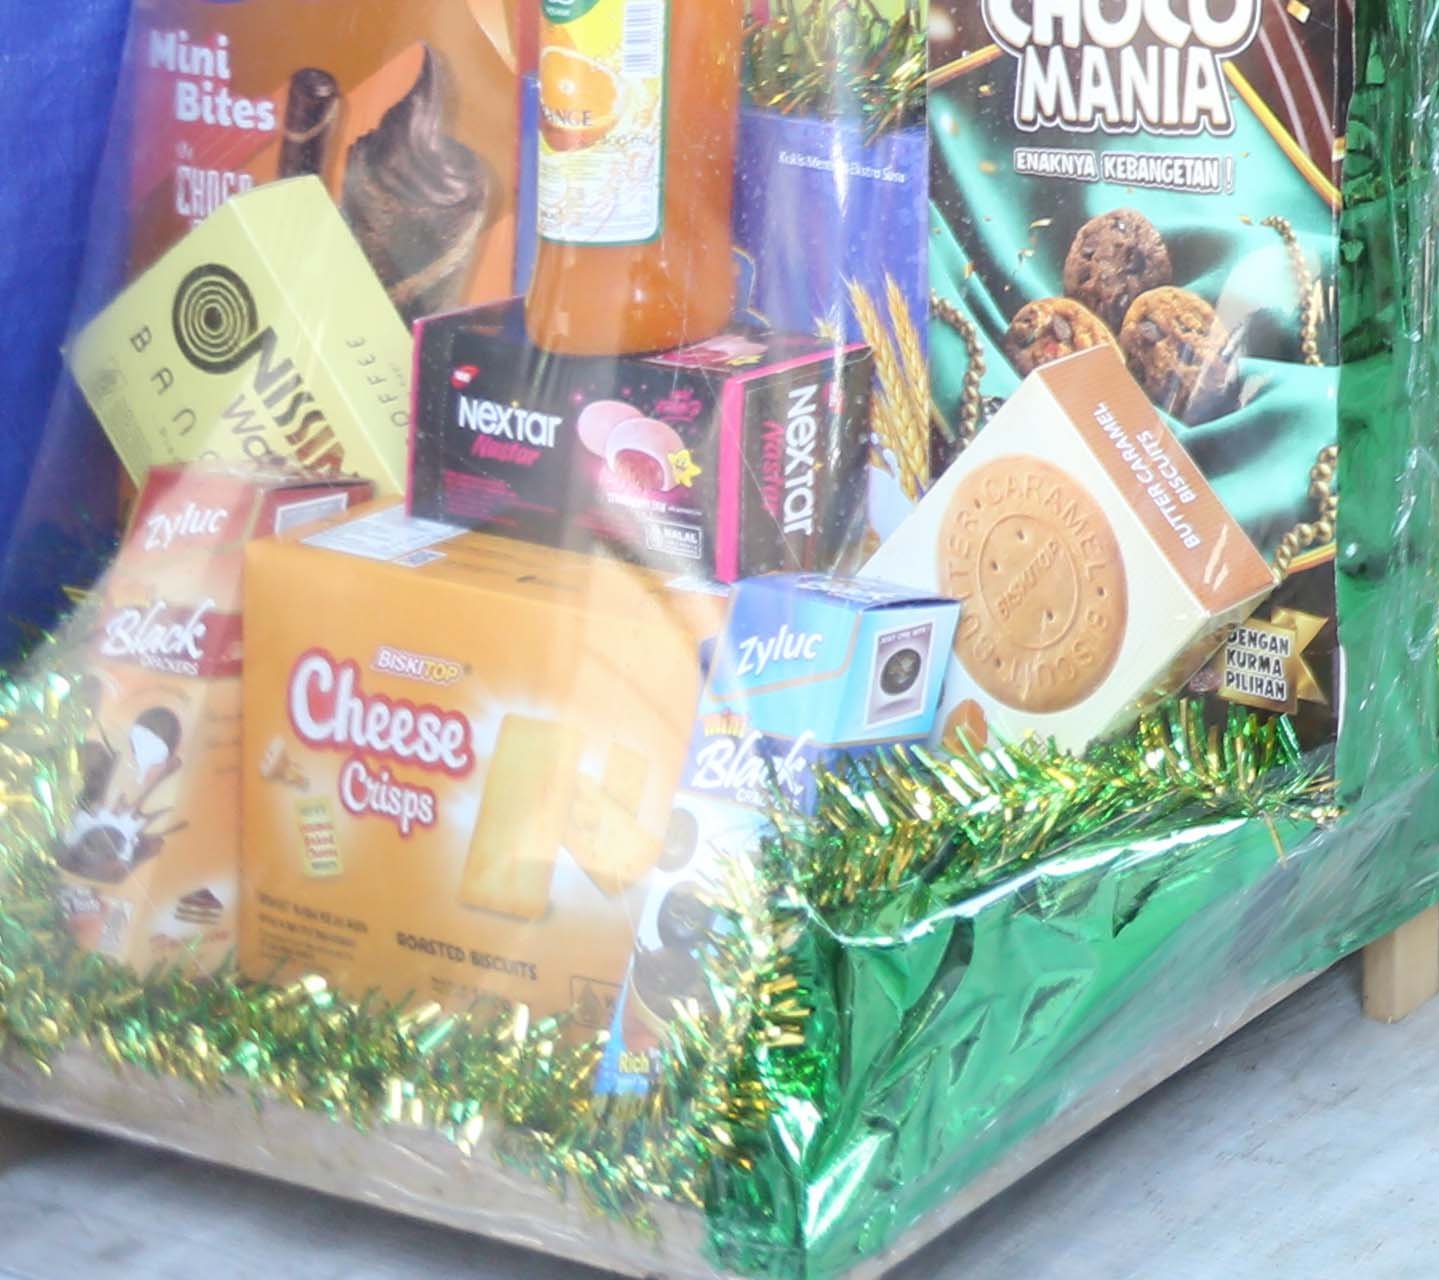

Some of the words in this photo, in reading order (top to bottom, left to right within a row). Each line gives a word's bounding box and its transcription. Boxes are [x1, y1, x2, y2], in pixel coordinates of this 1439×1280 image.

[149, 30, 232, 80] Mini
[174, 80, 276, 132] Bites
[1017, 44, 1232, 134] MANIA
[1015, 148, 1098, 180] ENAKNYA
[1100, 152, 1222, 192] KEBANGETAN
[1090, 401, 1155, 484] CARAMEL
[1136, 428, 1197, 505] BISCUITS
[1147, 482, 1201, 550] BUTTER
[378, 650, 459, 683] BISKITOP
[1223, 647, 1284, 679] KURMA
[1224, 669, 1288, 701] PILIHAN
[290, 656, 470, 770] Cheese
[342, 761, 436, 836] Crisps
